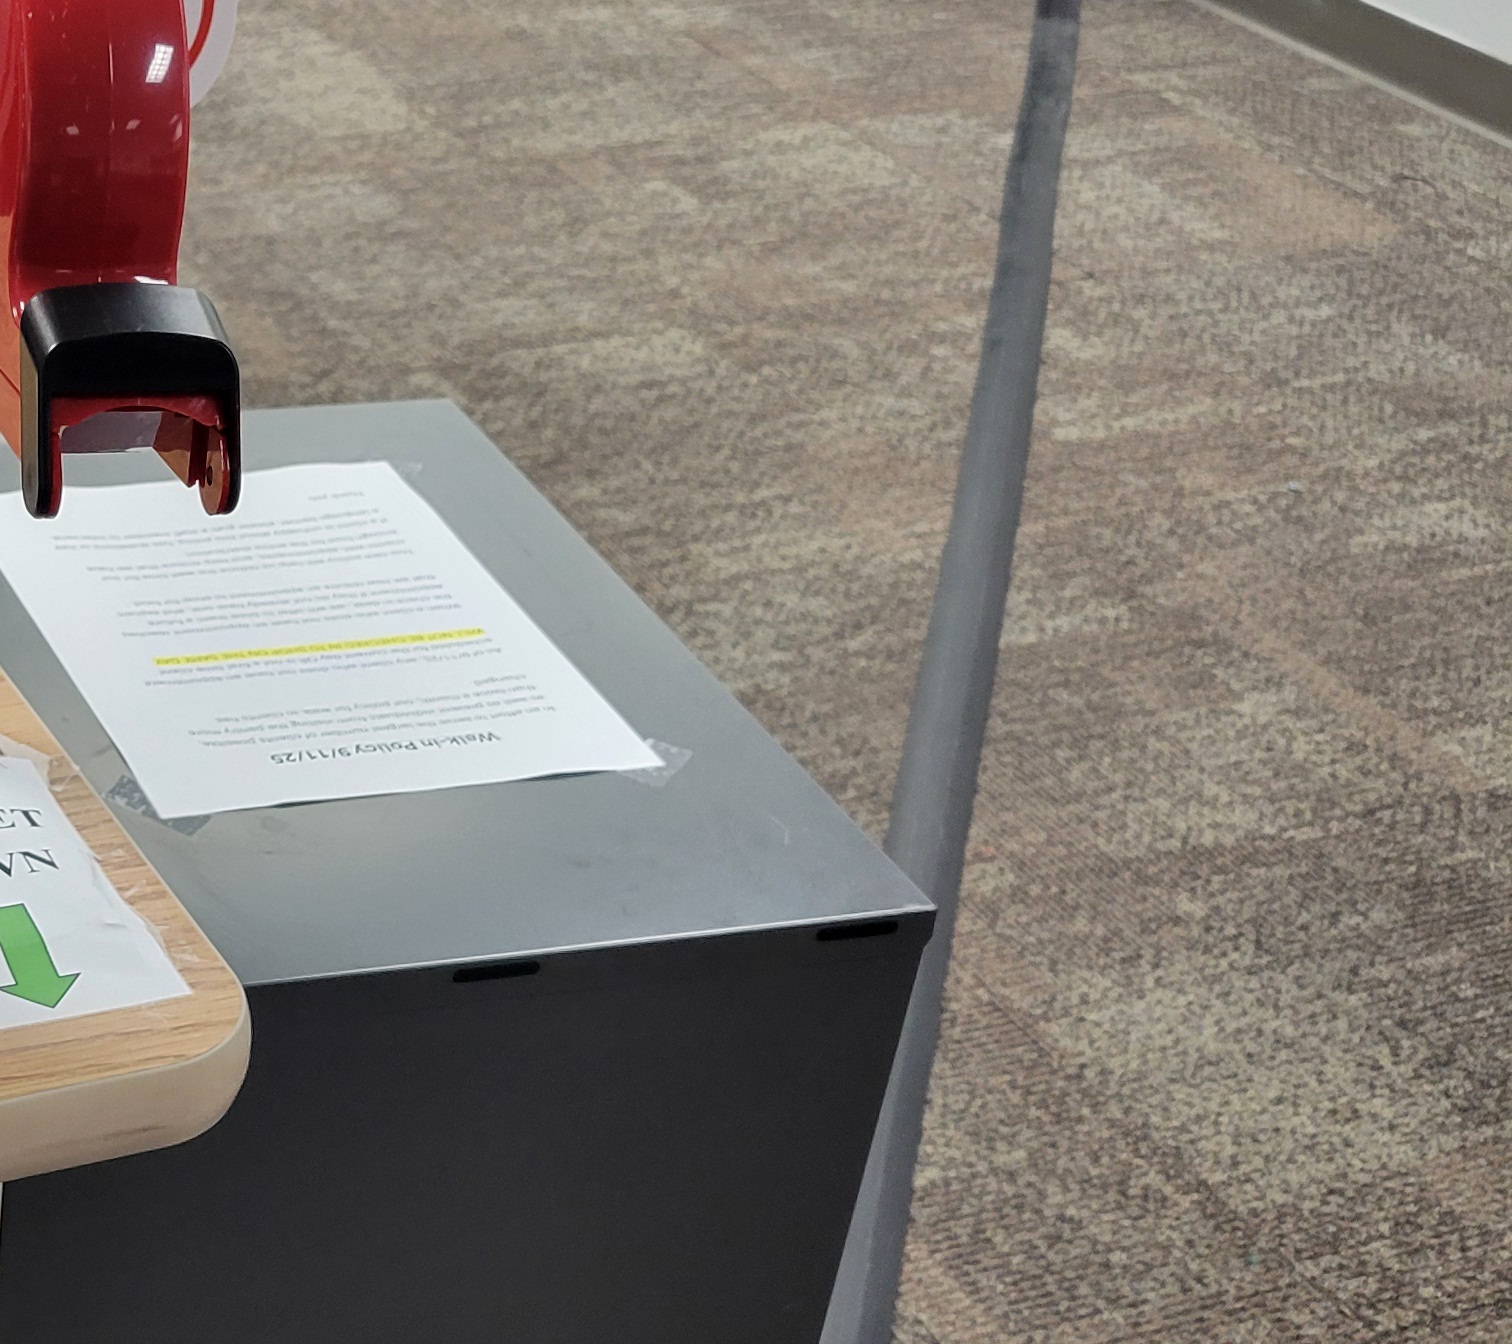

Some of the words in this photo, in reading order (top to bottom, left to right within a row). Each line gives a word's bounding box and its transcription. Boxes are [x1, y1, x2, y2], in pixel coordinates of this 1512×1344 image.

[353, 739, 419, 754] Policy
[418, 730, 501, 749] Walk-in
[269, 746, 352, 764] 9/11/25
